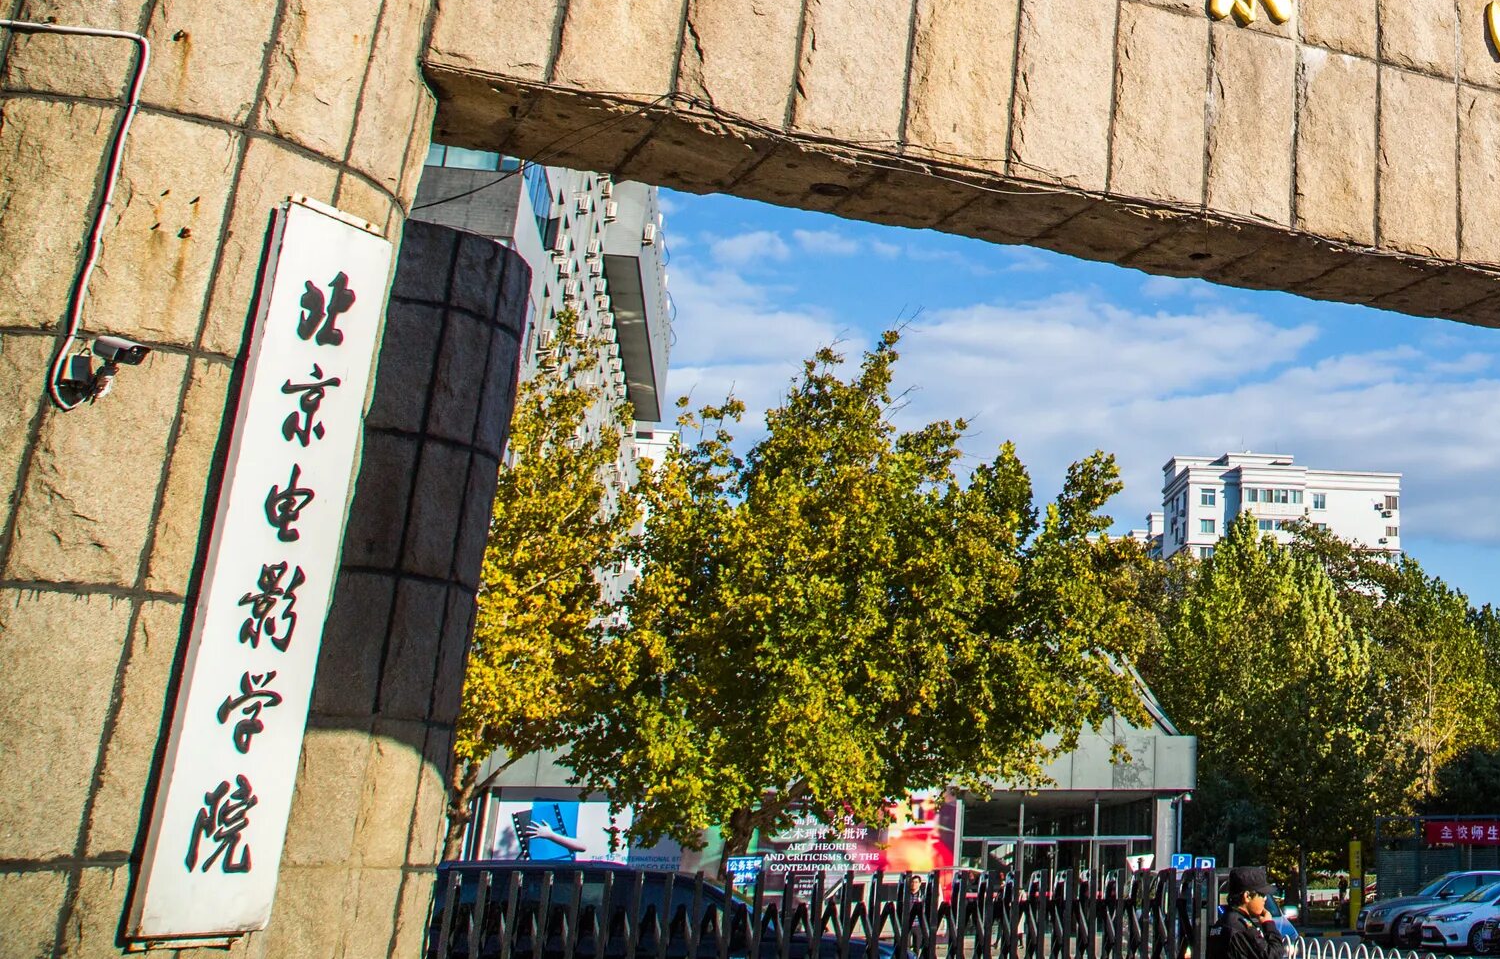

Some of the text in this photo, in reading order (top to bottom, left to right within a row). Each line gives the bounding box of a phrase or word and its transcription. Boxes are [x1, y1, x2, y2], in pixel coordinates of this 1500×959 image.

[185, 271, 356, 874] 北京电影学院
[788, 843, 857, 851] ART THEORIES
[764, 853, 880, 861] AND CRITICISMS OF THE
[1178, 856, 1185, 866] P
[770, 863, 871, 871] CONTEMPORARY ERA
